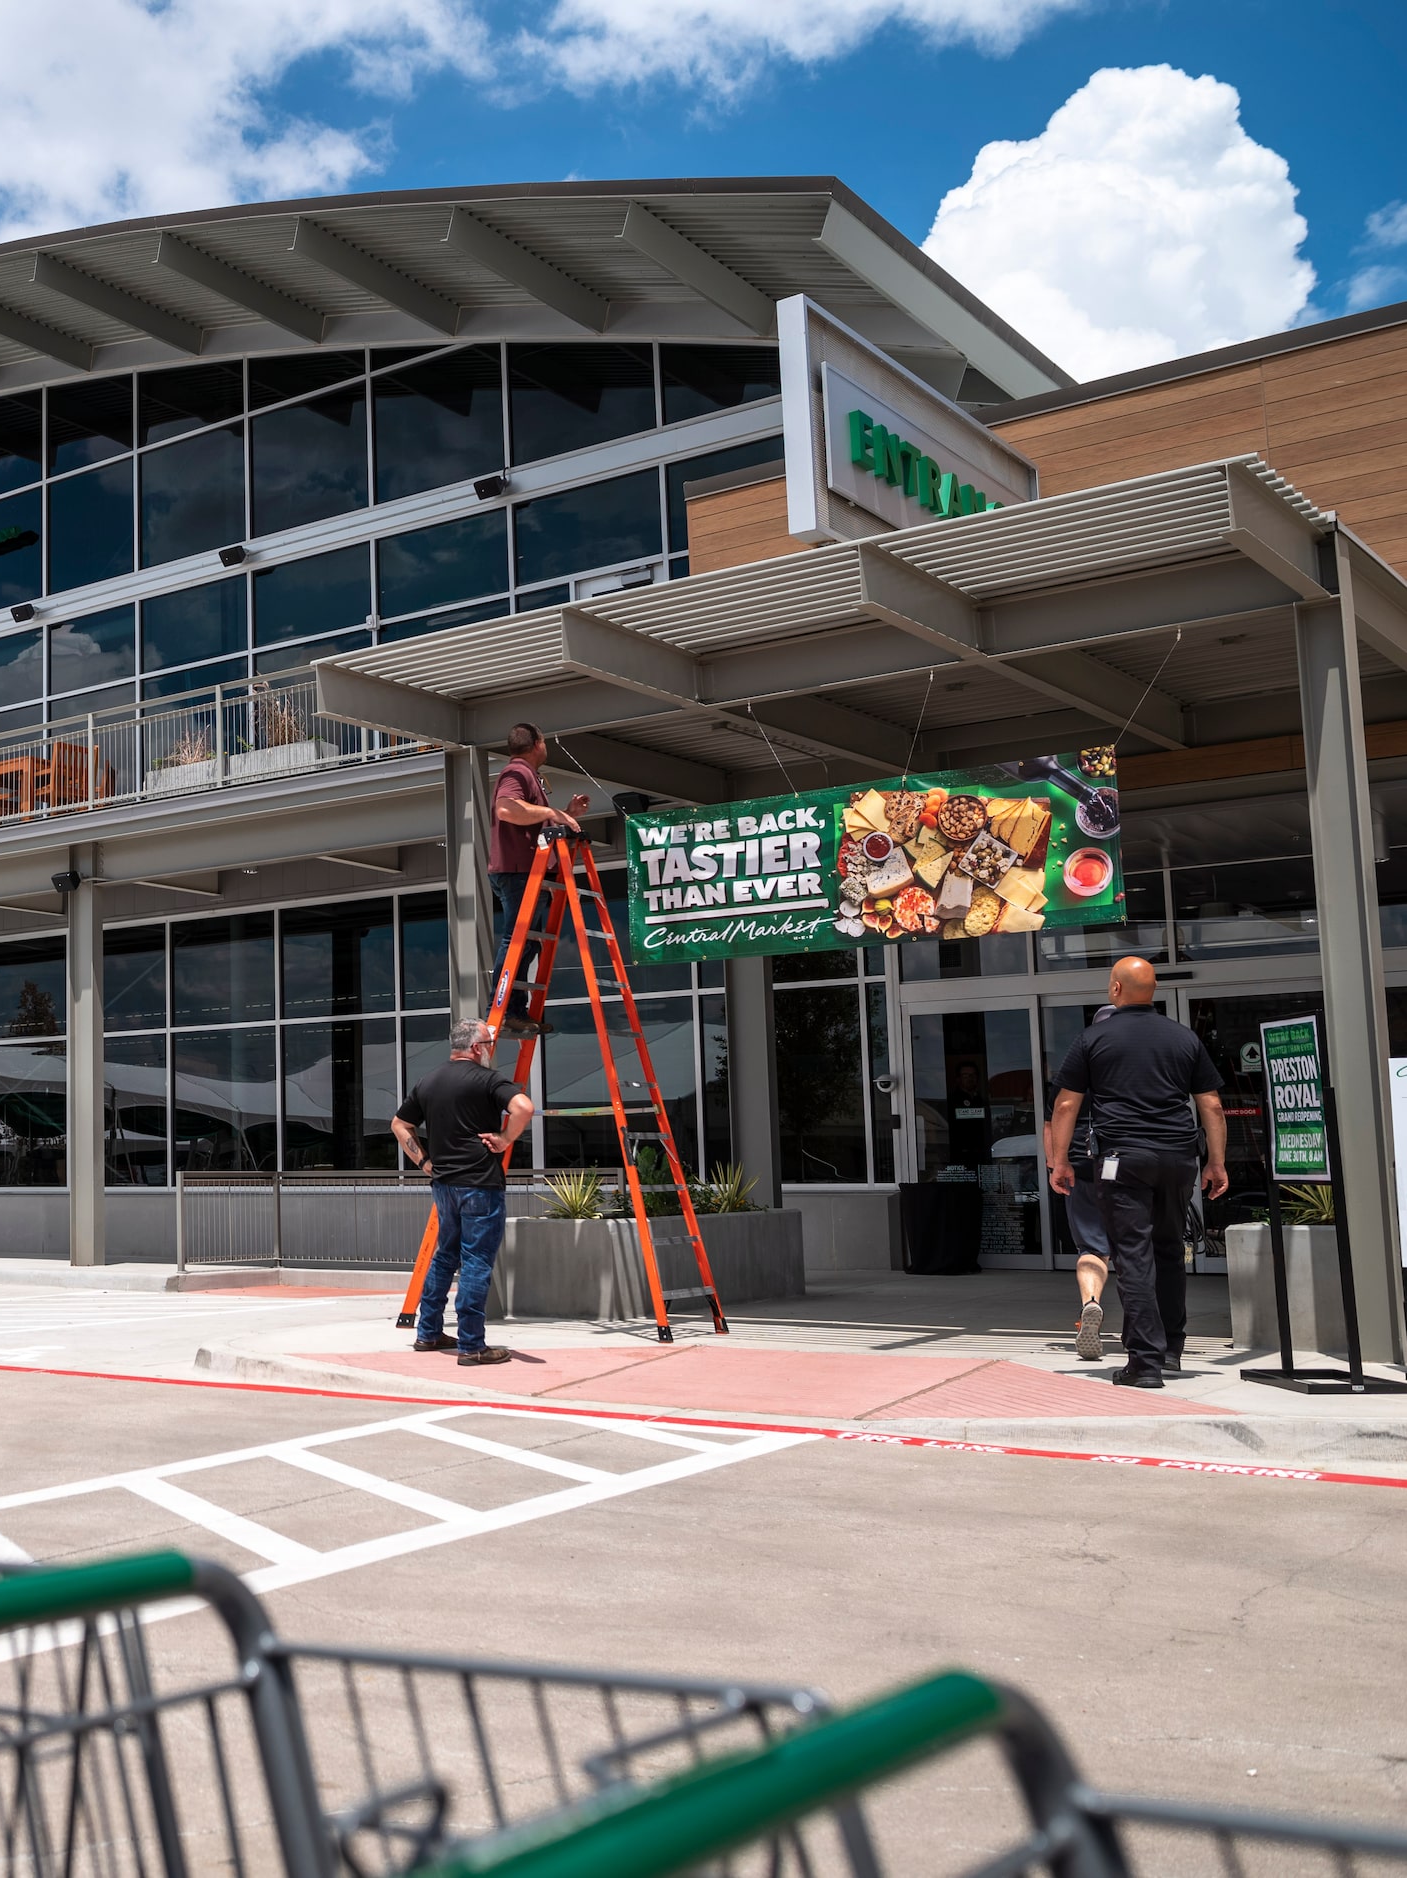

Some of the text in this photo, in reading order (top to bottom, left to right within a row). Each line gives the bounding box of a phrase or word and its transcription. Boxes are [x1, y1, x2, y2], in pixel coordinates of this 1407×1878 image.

[848, 409, 1005, 520] ENTRAN
[637, 806, 826, 846] WE'RE BACK,
[639, 831, 822, 886] TASTIER
[643, 872, 824, 912] THAN EVER
[643, 915, 838, 949] Central Market
[1269, 1045, 1287, 1055] TASTIER
[1301, 1043, 1313, 1051] EVER
[1270, 1055, 1318, 1082] PRESTON
[1274, 1083, 1321, 1109] ROYAL
[1277, 1110, 1322, 1122] GRAND REOPENING
[1279, 1133, 1321, 1149] WEDNESDAY
[1278, 1150, 1323, 1163] JUNE 30TH, 8 AM
[837, 1431, 1006, 1454] FIRE LANE
[1090, 1455, 1323, 1481] NO PARKING
